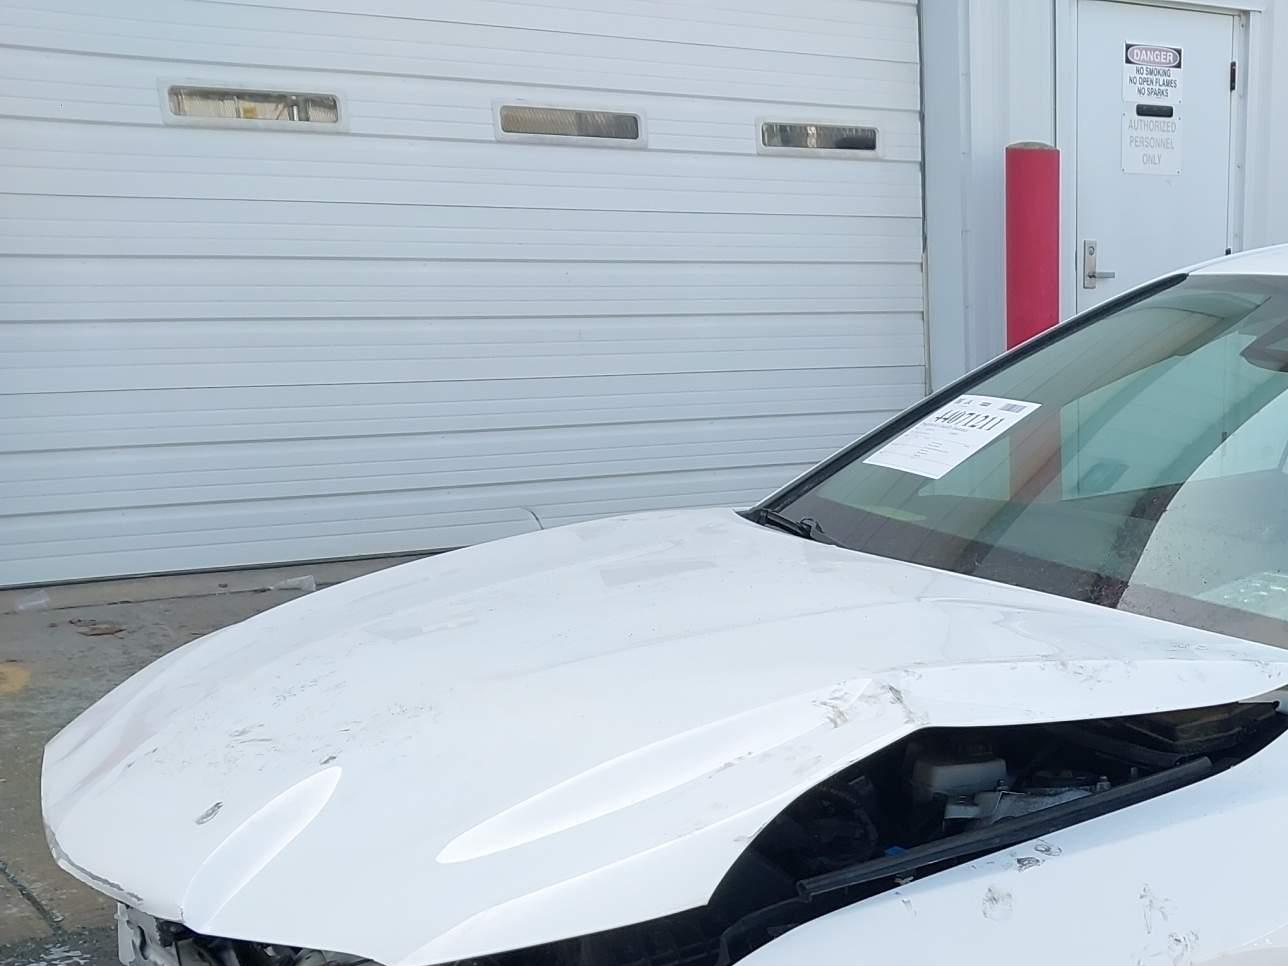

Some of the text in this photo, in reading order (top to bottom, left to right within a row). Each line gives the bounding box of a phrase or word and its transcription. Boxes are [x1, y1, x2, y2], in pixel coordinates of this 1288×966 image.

[1133, 49, 1174, 63] DANGER
[1135, 66, 1171, 78] NO SMOKING
[1128, 76, 1177, 89] NO OPEN FLAMES
[1136, 87, 1169, 97] NO SPARKS
[1128, 119, 1177, 133] AUTHORIZED
[1129, 135, 1175, 150] PERSONNEL
[1142, 152, 1162, 166] ONLY
[935, 409, 1005, 431] 44071211
